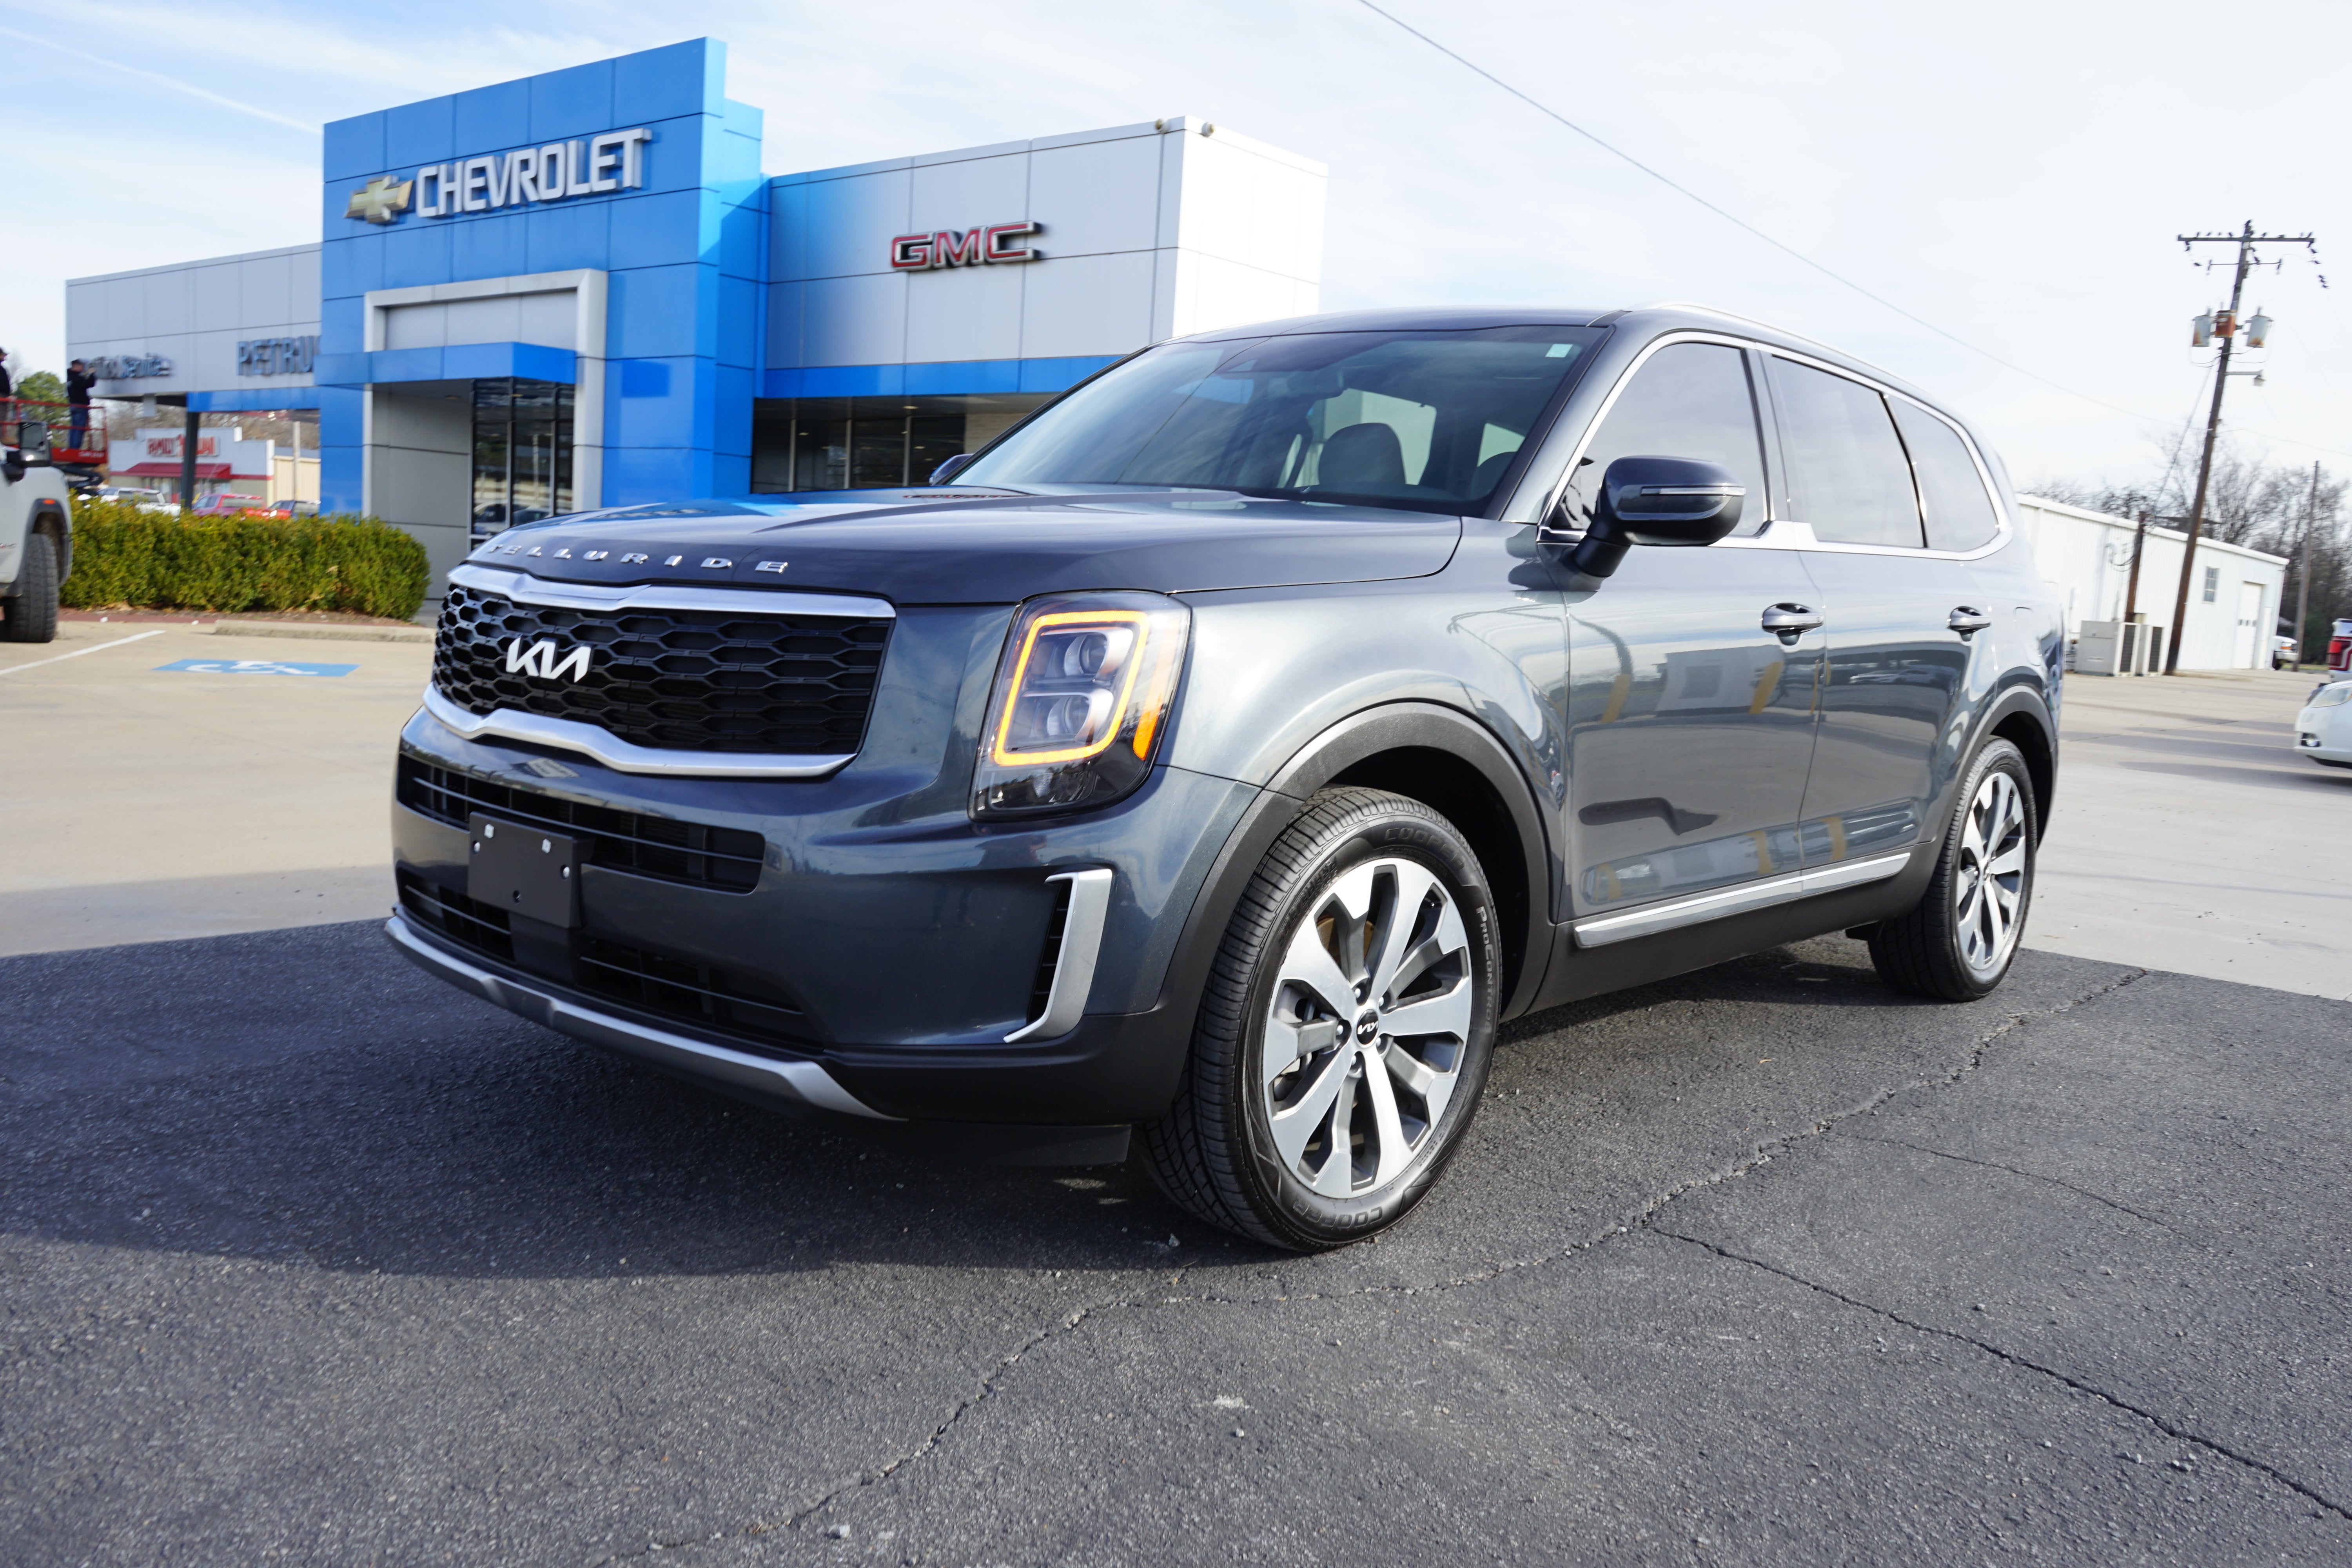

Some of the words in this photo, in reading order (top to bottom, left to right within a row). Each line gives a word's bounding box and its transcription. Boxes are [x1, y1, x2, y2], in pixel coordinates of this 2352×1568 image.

[416, 127, 652, 218] CHEVROLET
[891, 220, 1042, 272] GMC
[486, 544, 789, 574] TELLURIDE
[506, 636, 592, 683] KIA
[1384, 827, 1466, 871] COOPER
[1292, 1200, 1383, 1229] COOPER
